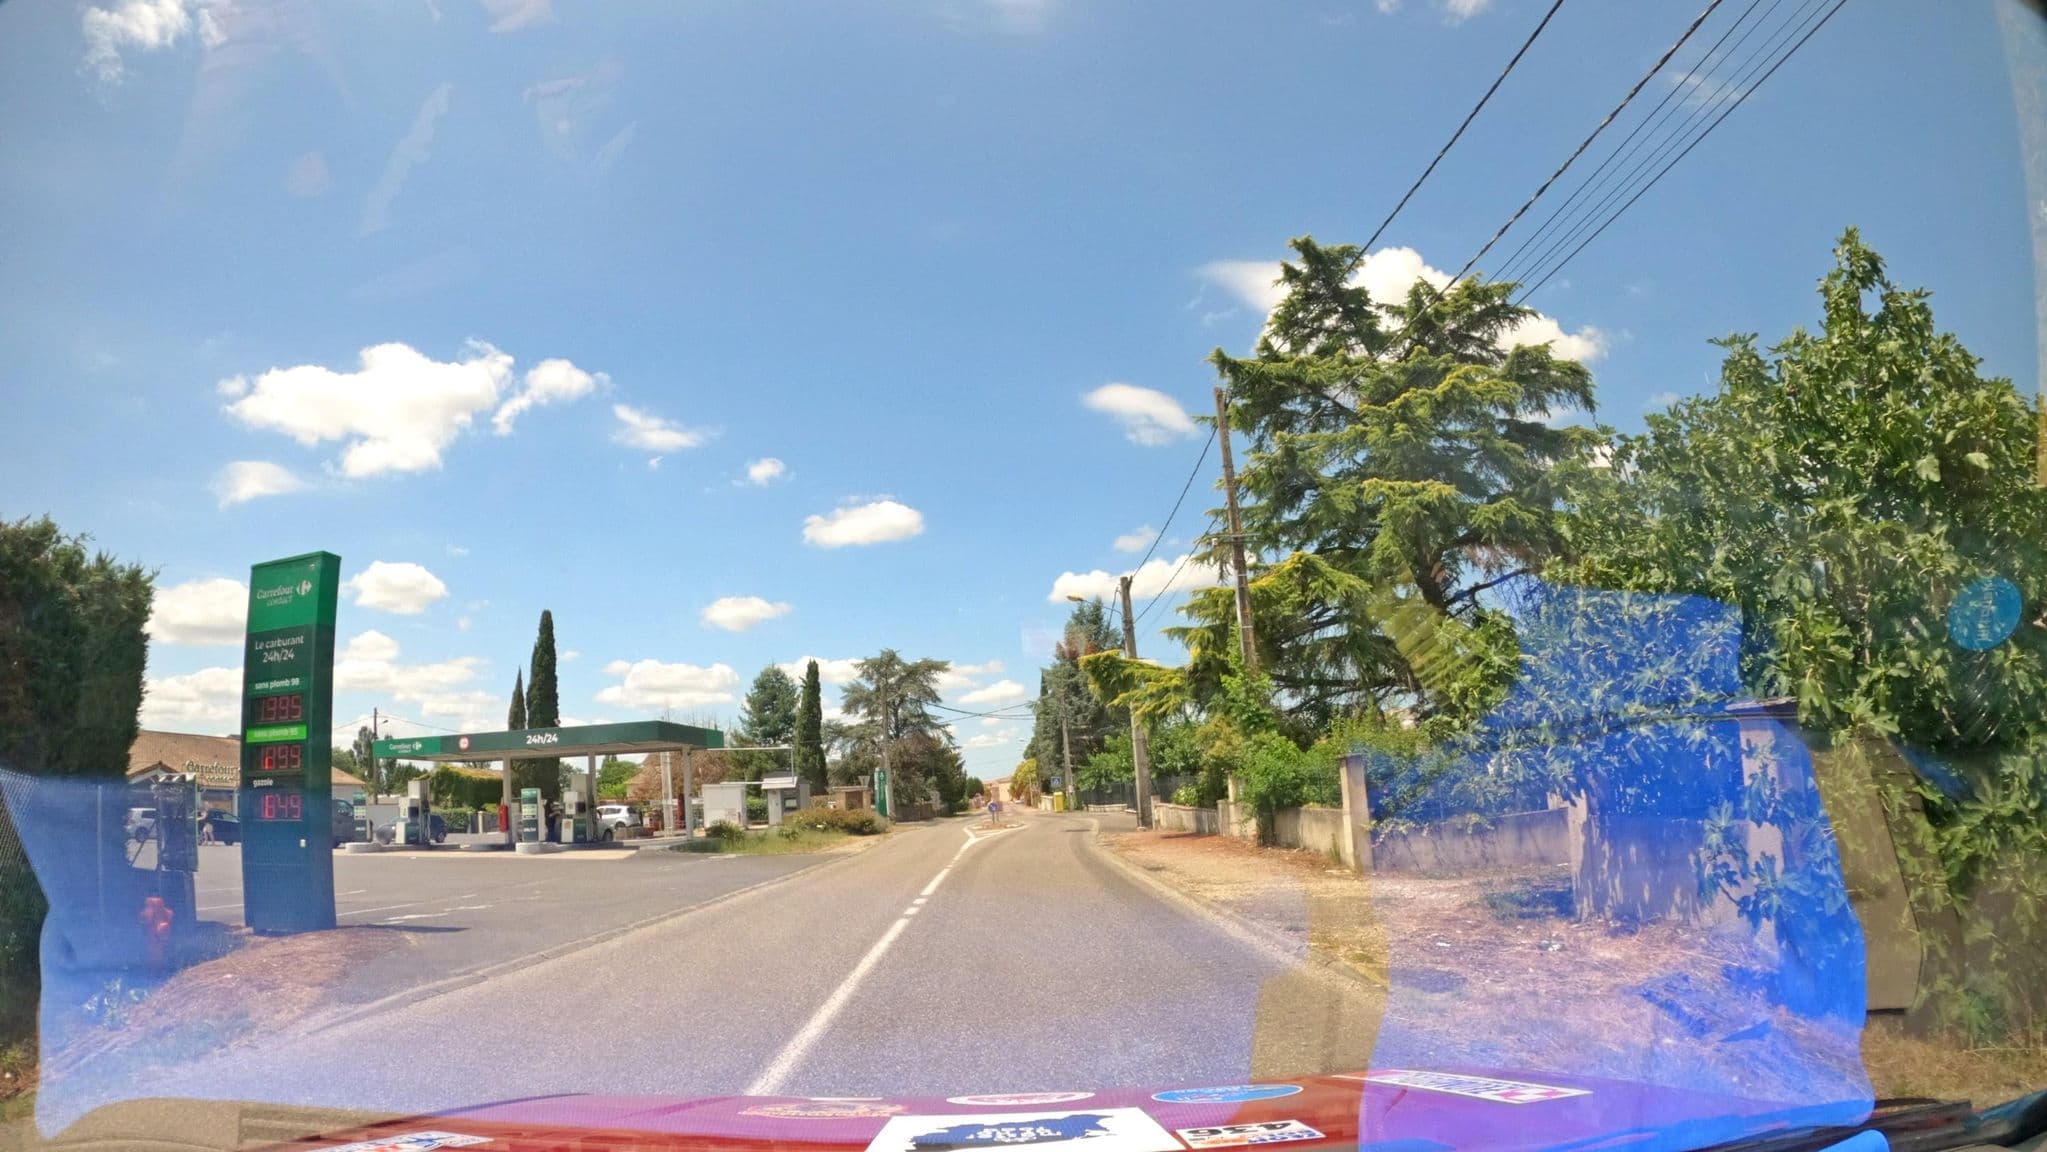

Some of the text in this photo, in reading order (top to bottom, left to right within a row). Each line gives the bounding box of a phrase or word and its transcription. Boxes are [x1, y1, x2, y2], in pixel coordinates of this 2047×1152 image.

[256, 585, 294, 599] Carrefour
[255, 635, 304, 650] Le carburant
[262, 648, 295, 663] 24h/24
[254, 682, 269, 690] sans
[269, 679, 290, 690] plomb
[526, 732, 559, 745] 24h/24
[252, 778, 274, 788] gazole
